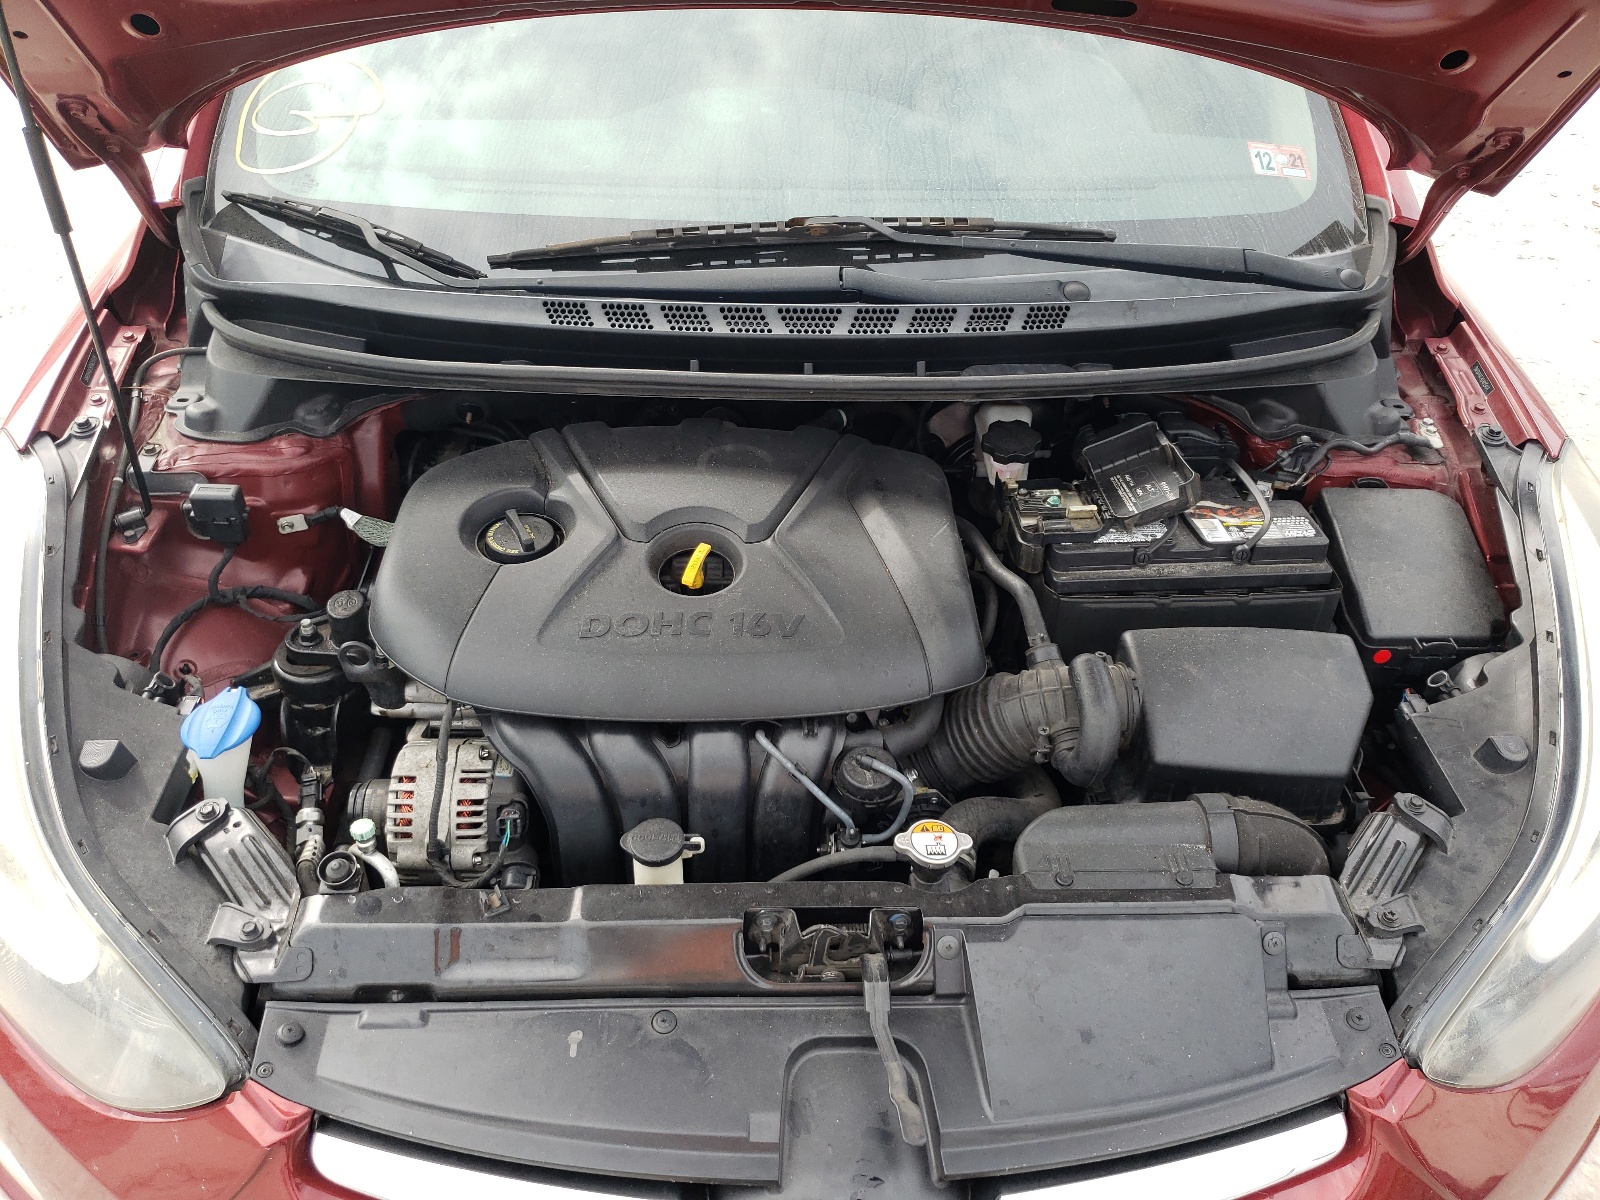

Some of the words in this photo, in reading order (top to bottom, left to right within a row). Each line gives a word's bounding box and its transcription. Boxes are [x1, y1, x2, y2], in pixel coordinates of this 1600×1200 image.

[1254, 150, 1276, 172] 12
[1288, 153, 1305, 169] 21
[579, 611, 713, 639] DOHC
[729, 611, 806, 640] 16V
